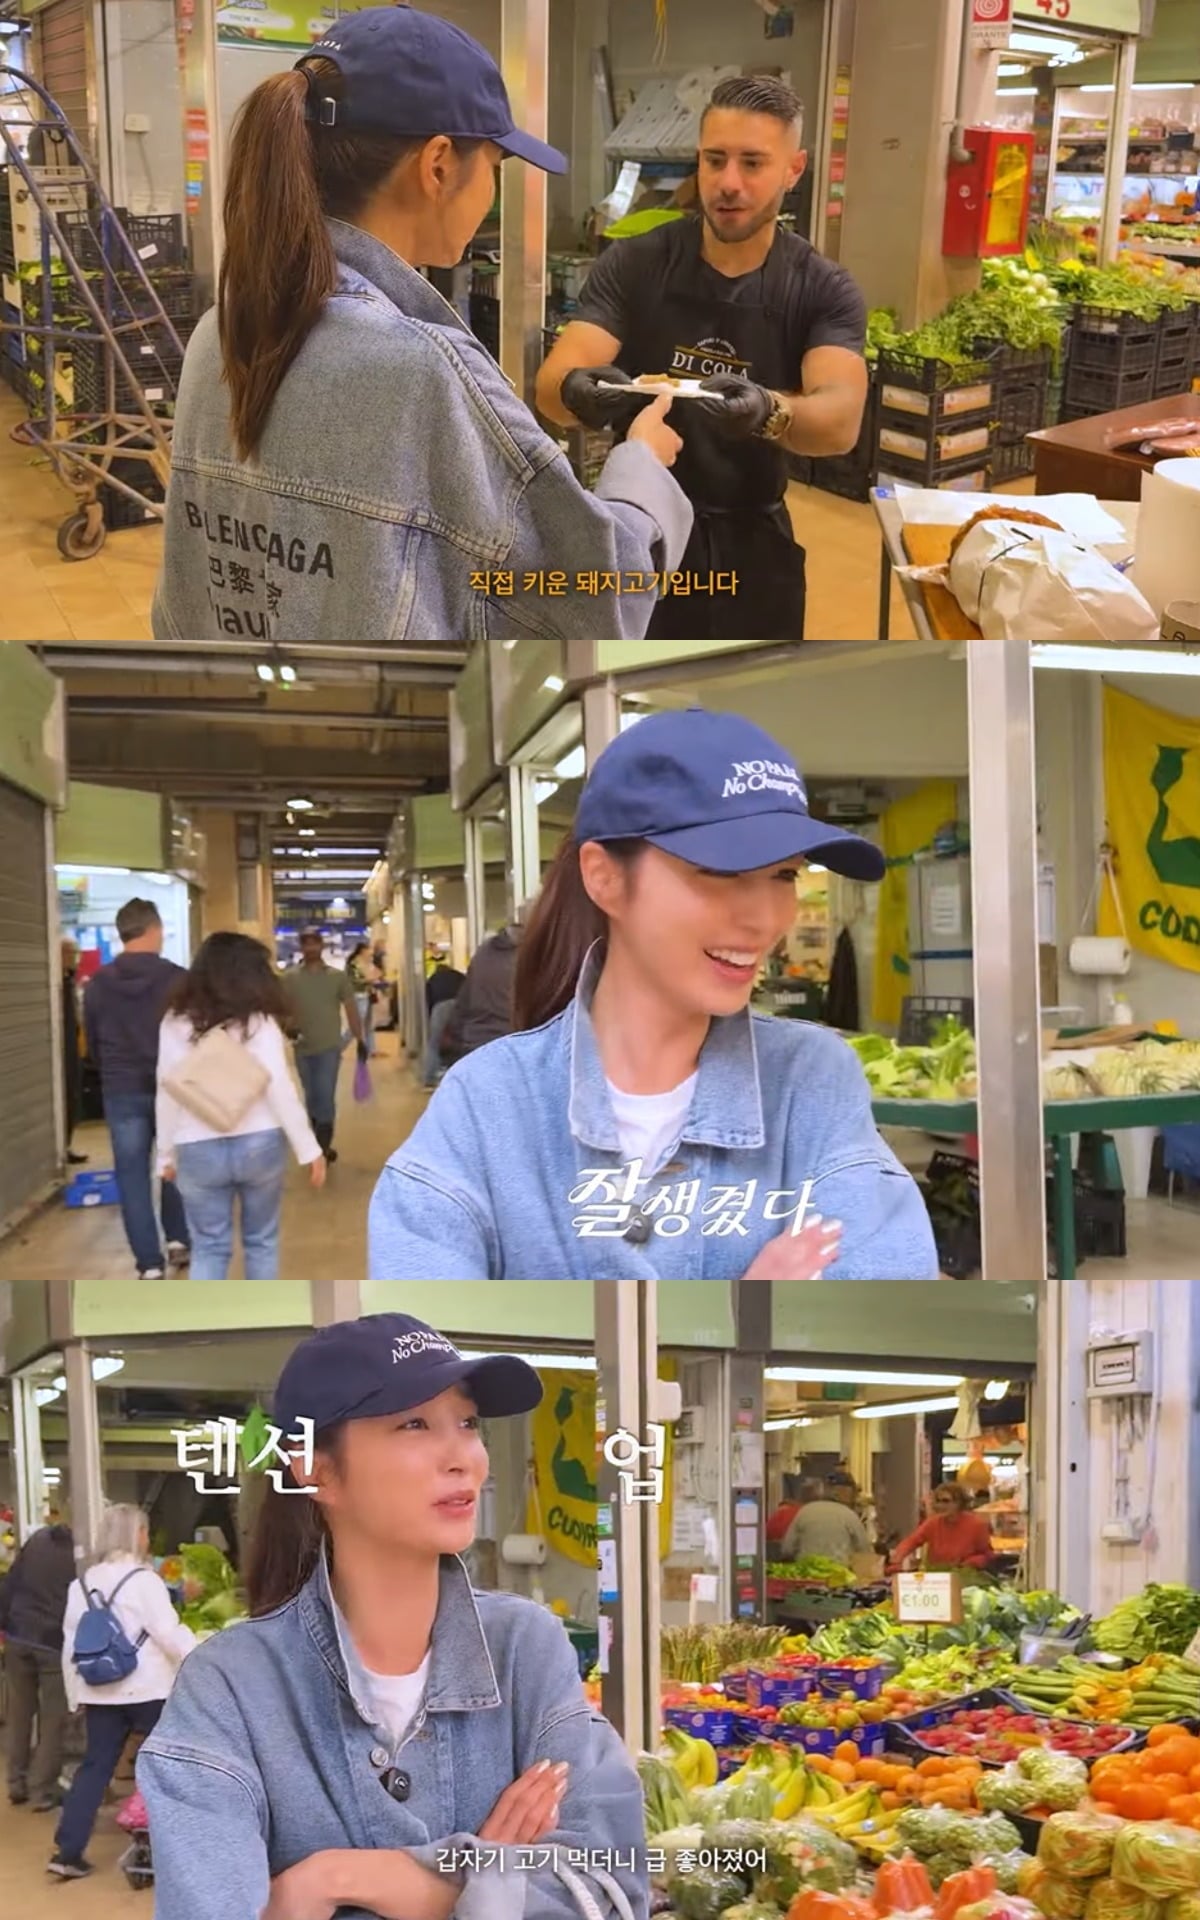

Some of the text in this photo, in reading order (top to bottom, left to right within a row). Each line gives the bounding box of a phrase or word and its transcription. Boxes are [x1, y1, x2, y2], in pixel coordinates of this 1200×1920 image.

[671, 351, 695, 371] DI
[731, 760, 765, 777] NO
[721, 777, 746, 798] No
[393, 1331, 421, 1346] NO
[391, 1346, 411, 1363] No
